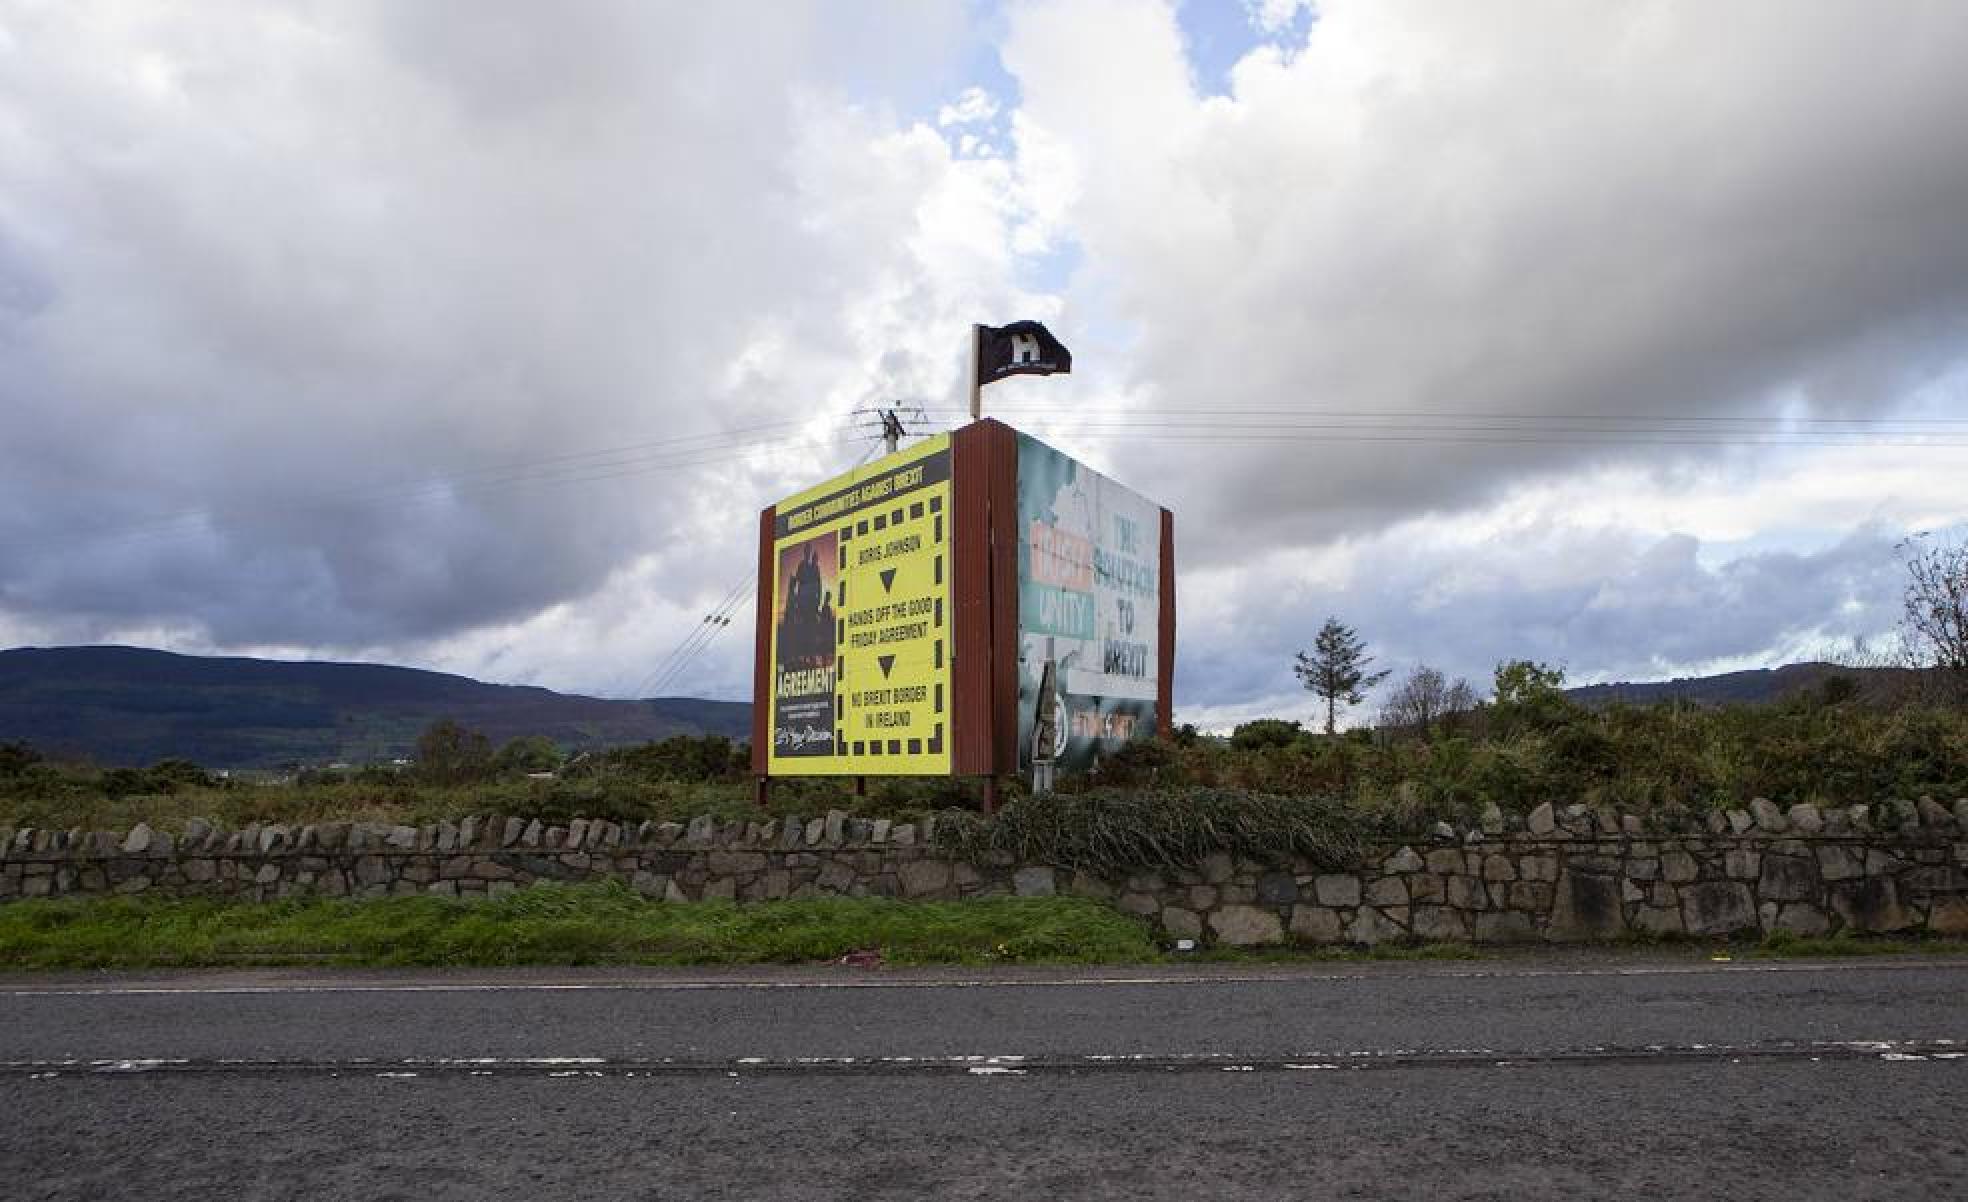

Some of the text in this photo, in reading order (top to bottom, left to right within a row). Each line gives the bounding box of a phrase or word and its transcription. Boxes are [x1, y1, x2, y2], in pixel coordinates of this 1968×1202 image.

[893, 466, 923, 491] BREXIT
[859, 535, 921, 565] BORIS JOHNSON
[848, 597, 932, 627] HANDS OFF THE GOOD
[1039, 590, 1087, 634] UNITY
[1118, 599, 1135, 633] TO
[851, 622, 928, 648] FRIDAY AGREEMENT
[1103, 638, 1148, 678] BREXIT
[777, 668, 834, 698] AGREEMENT
[852, 686, 927, 707] NO BREXIT BORDER
[865, 711, 911, 728] IN IRELAND
